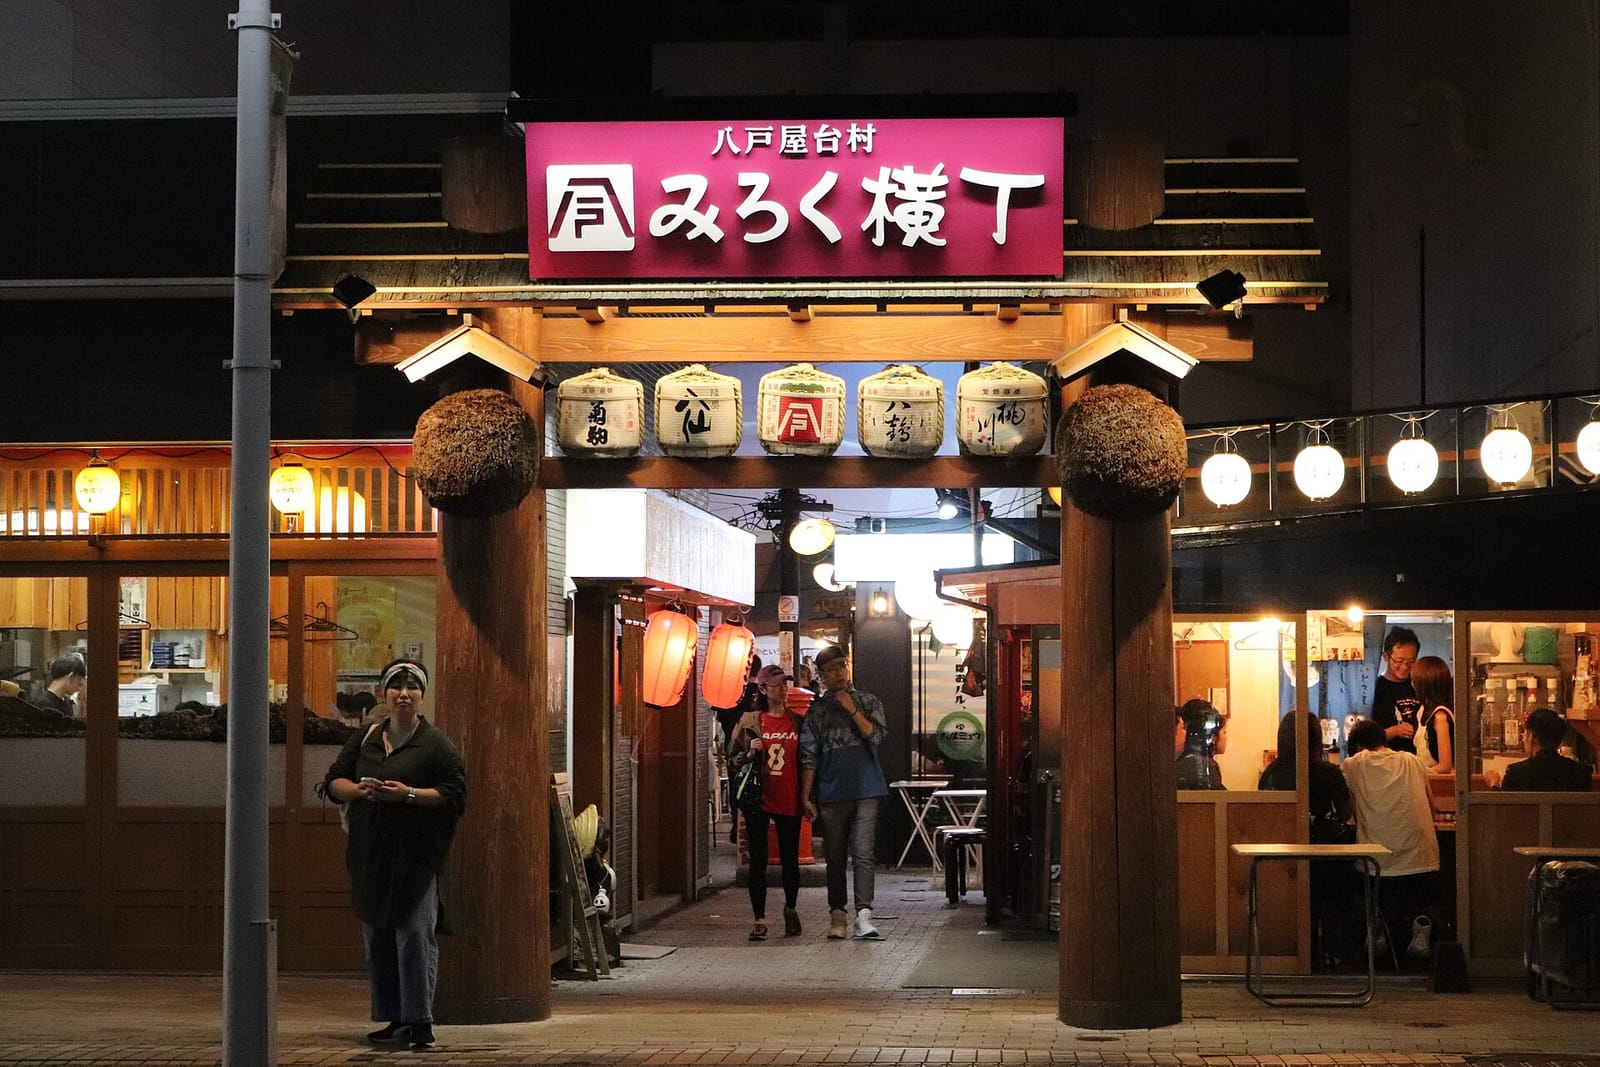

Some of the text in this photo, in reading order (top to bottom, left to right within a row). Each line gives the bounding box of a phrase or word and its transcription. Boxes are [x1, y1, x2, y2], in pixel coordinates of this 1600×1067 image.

[711, 123, 876, 156] 八戸屋台村
[649, 162, 1046, 248] みろく横丁
[586, 400, 608, 446] 菊駒
[674, 387, 712, 443] 八仙
[977, 400, 1026, 446] 桃川
[761, 732, 798, 741] APAN
[767, 743, 785, 771] 8
